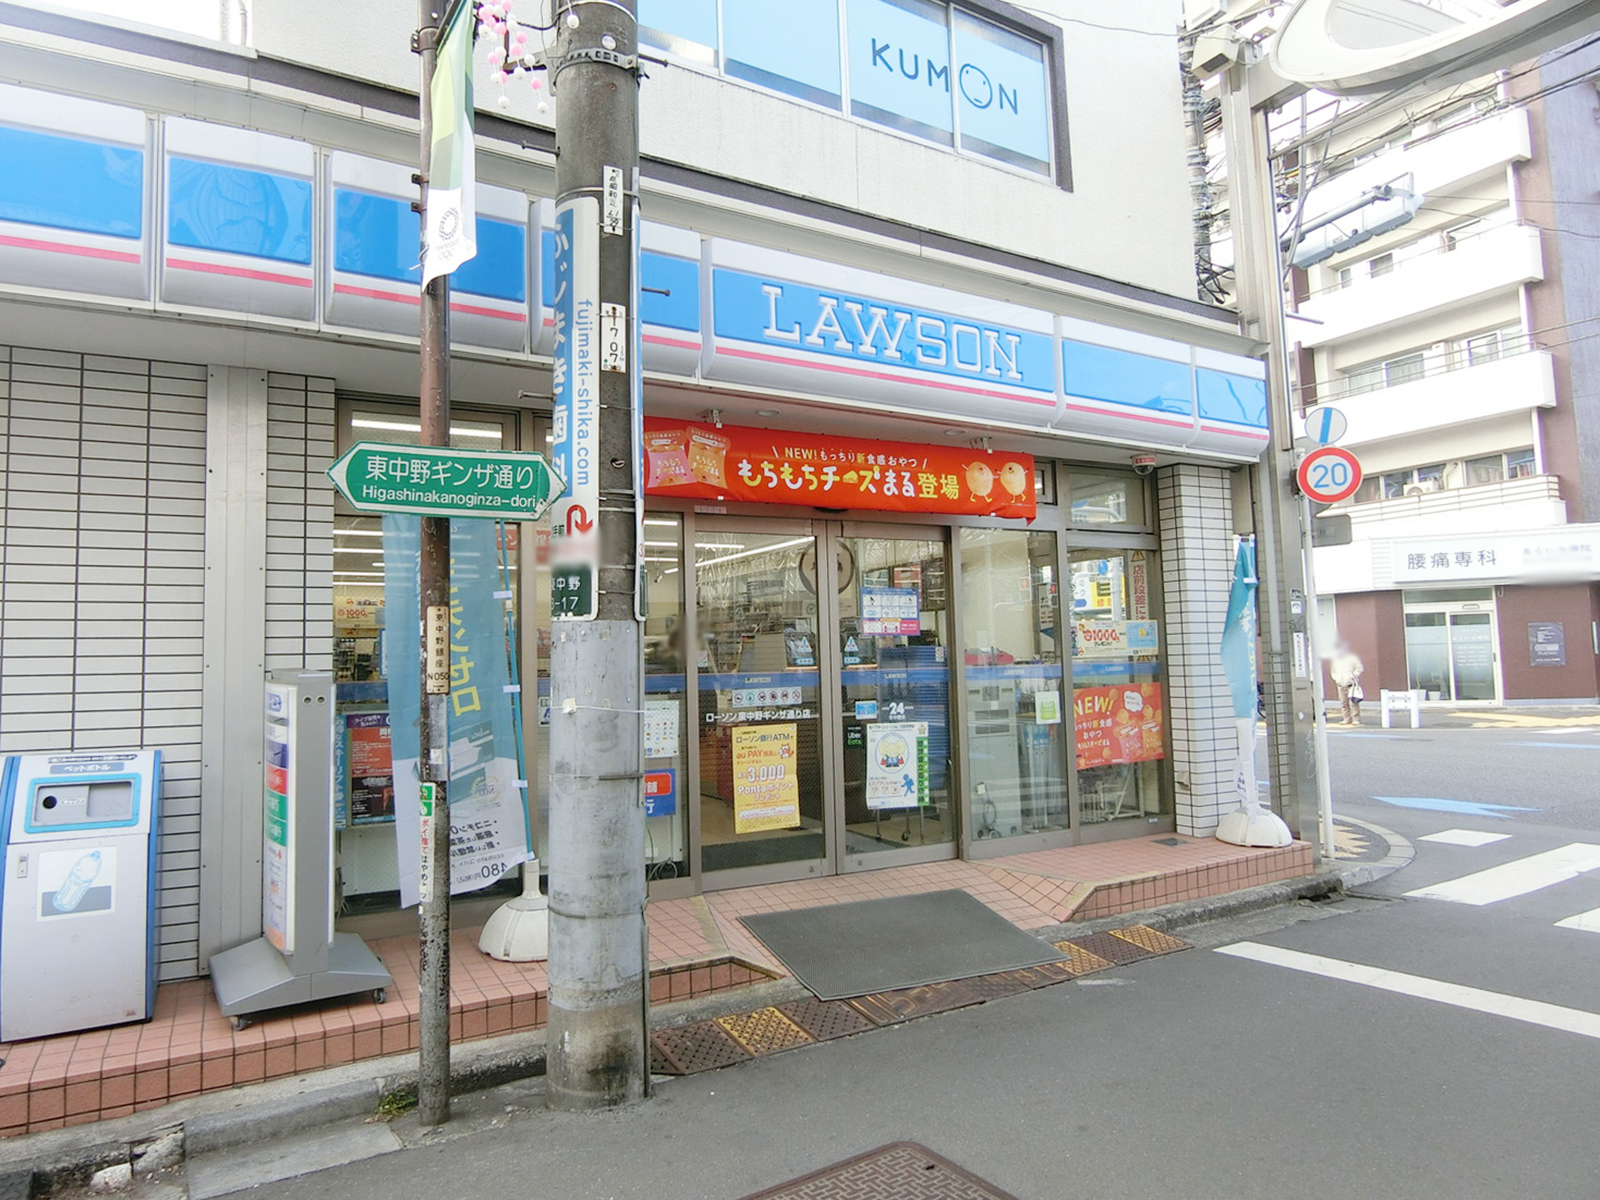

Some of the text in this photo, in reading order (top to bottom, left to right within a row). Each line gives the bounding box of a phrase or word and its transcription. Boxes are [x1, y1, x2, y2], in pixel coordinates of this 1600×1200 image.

[871, 38, 1018, 115] KUMON
[761, 283, 1023, 382] LAWSON
[577, 299, 594, 486] fujimaki-shika.com
[784, 446, 817, 461] NEW!
[365, 454, 534, 490] 東中野ギンザ通り
[1312, 462, 1348, 488] 20
[362, 484, 536, 508] Higashinakanoginza-dori
[1407, 550, 1497, 570] 腰痛専科
[435, 613, 445, 668] 東中野銀座
[889, 702, 905, 715] 24
[1073, 695, 1114, 719] NEW!
[64, 764, 111, 773] ペットボトル
